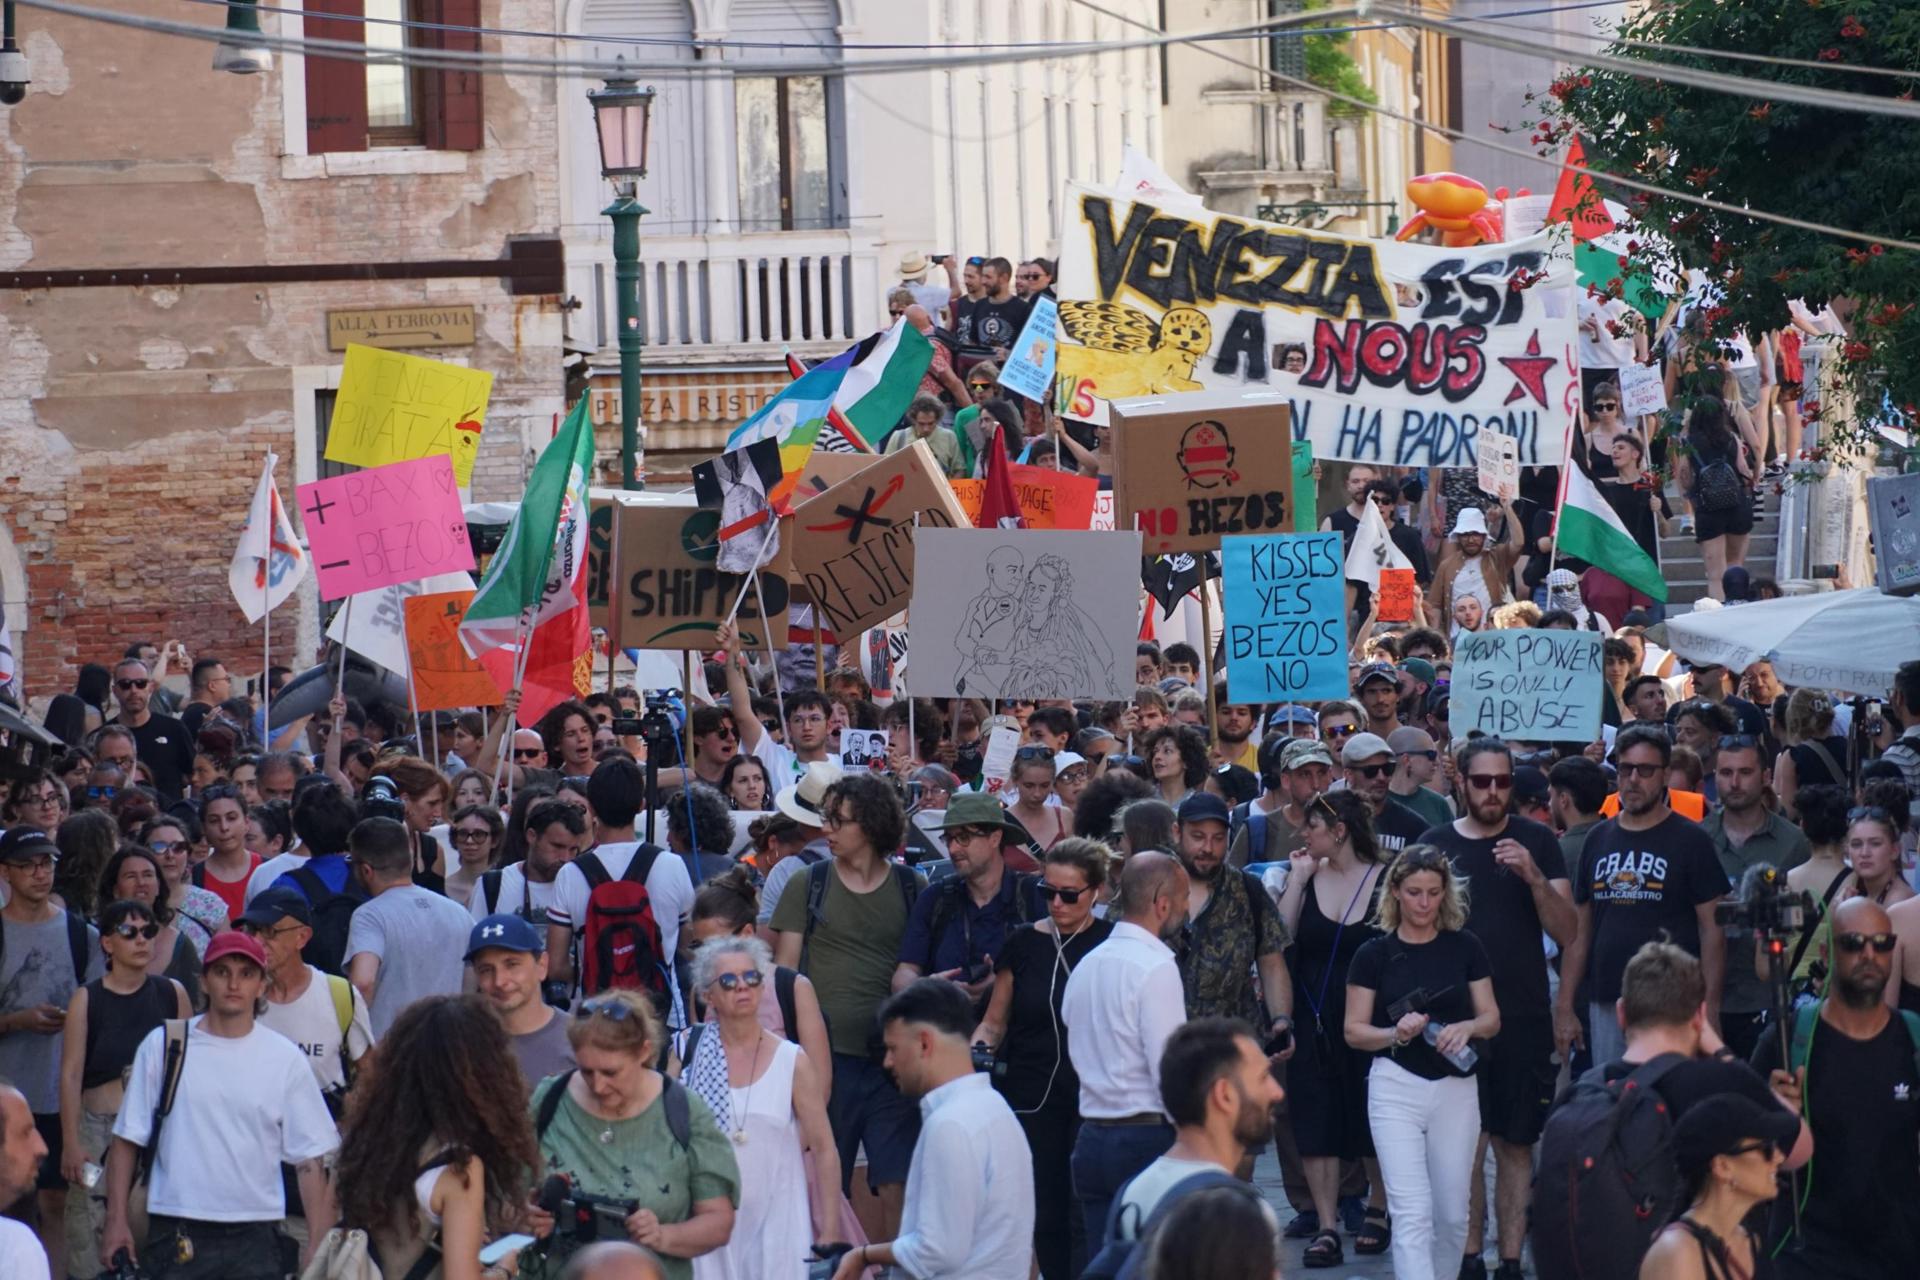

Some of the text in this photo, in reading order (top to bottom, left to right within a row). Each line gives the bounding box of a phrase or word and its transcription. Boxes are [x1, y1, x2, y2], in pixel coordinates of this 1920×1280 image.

[1081, 194, 1545, 326] VENEZIA EST
[334, 311, 470, 331] ALLA FERROVIA
[1213, 309, 1487, 403] A NOUS
[350, 353, 486, 411] VENEZIA
[596, 397, 675, 415] PIZA
[333, 401, 454, 459] PIRATA
[1336, 405, 1382, 460] HA
[1395, 409, 1538, 467] PADRONI
[1137, 507, 1179, 537] NO
[1187, 491, 1285, 536] BEZOS
[804, 507, 953, 633] REJECT
[1251, 537, 1339, 582] KISSES
[1255, 582, 1312, 619] YES
[1231, 619, 1338, 660] BEZOS
[1463, 634, 1601, 673] YOUR POWER
[1265, 659, 1310, 693] NO
[1500, 674, 1574, 699] ONLY
[1477, 696, 1585, 733] ABUSE
[1594, 850, 1668, 881] CRABS
